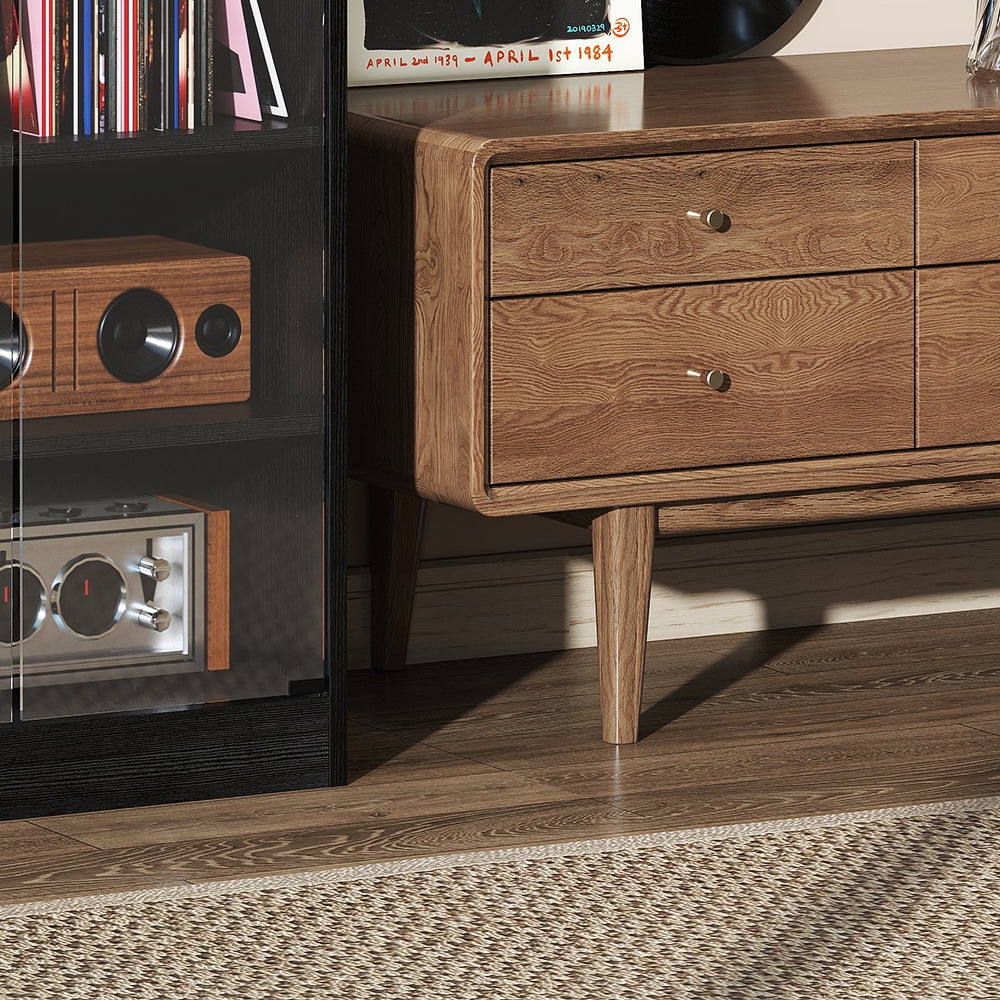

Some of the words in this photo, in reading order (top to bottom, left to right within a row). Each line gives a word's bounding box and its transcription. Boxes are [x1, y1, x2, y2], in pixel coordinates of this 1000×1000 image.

[566, 23, 605, 33] 20190329
[366, 57, 408, 70] APRIL
[411, 55, 428, 67] 2nd
[434, 54, 458, 68] 1939
[484, 49, 540, 67] APRIL
[549, 46, 571, 63] 1st
[578, 43, 613, 63] 1984
